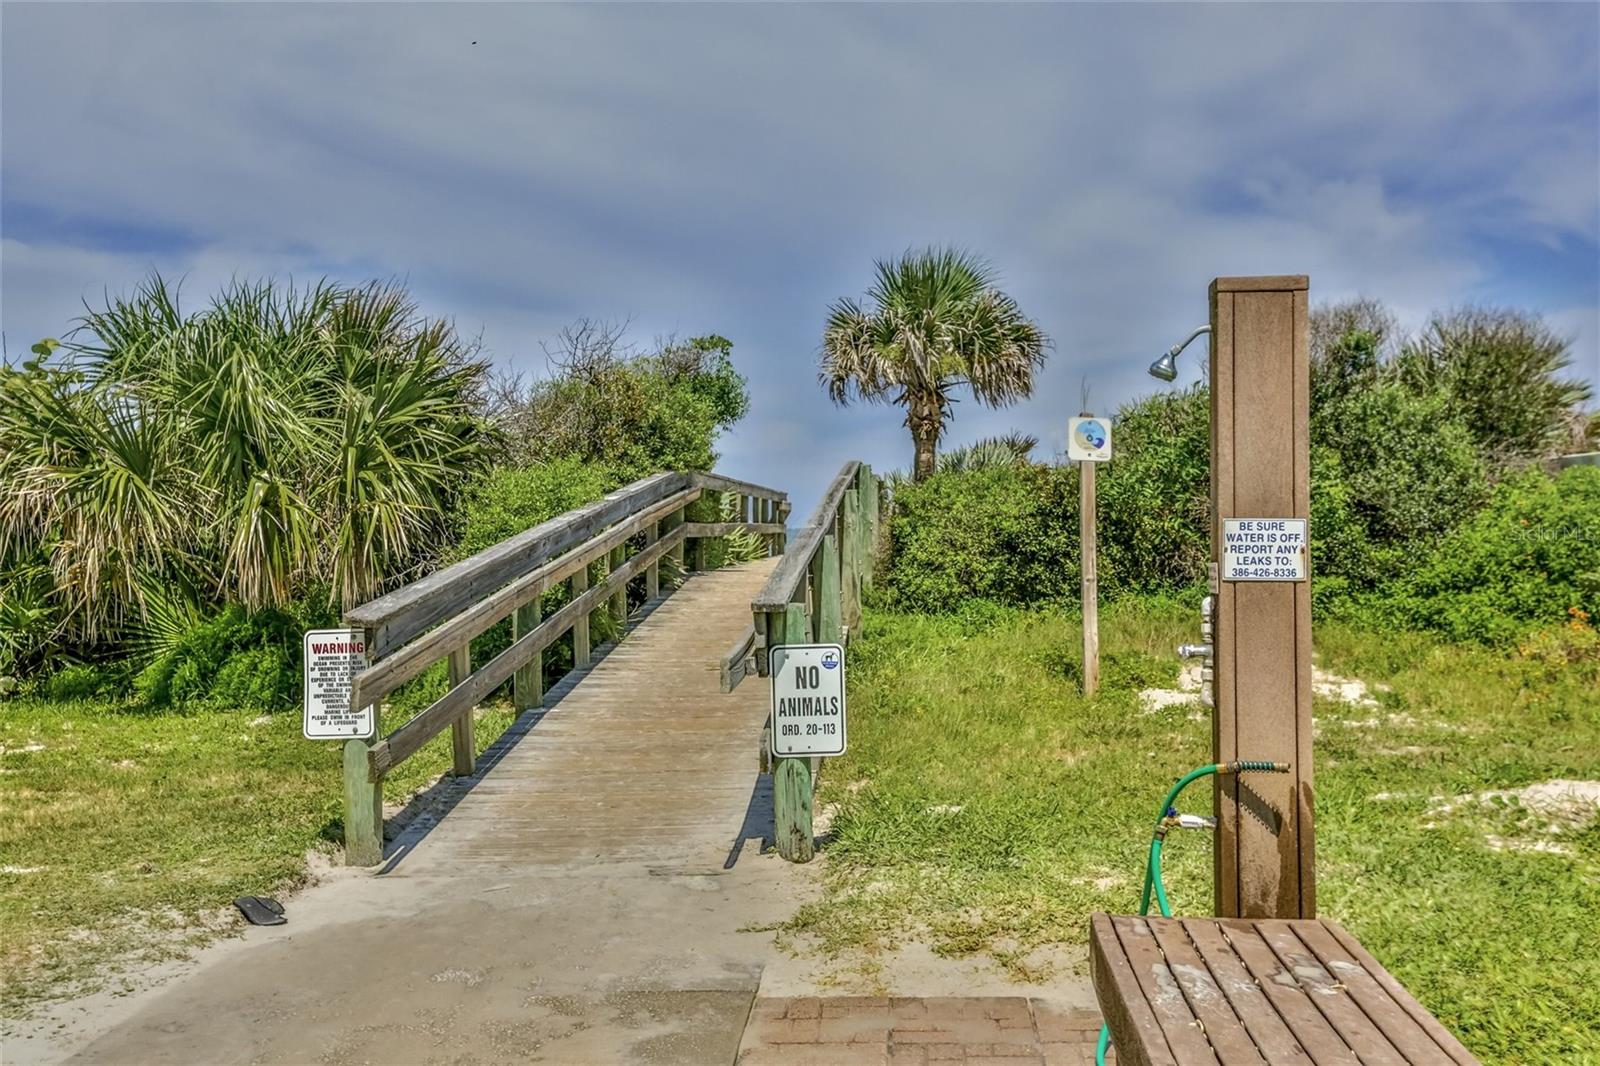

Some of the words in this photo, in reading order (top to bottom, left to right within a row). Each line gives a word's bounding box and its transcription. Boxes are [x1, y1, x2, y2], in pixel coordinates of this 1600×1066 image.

[1239, 522, 1253, 531] BE
[1256, 522, 1285, 531] SURE
[1226, 533, 1264, 542] WATER
[1267, 533, 1276, 542] IS
[1280, 533, 1303, 542] OFF.
[1230, 545, 1273, 554] REPORT
[1276, 545, 1298, 554] ANY
[1236, 556, 1272, 566] LEAKS
[1274, 556, 1292, 566] TO:
[1232, 568, 1297, 577] 386-426-8336
[312, 642, 364, 654] WARNING
[796, 666, 820, 690] NO
[779, 697, 838, 717] ANIMALS
[782, 724, 802, 736] ORD.
[806, 723, 836, 736] 20-113
